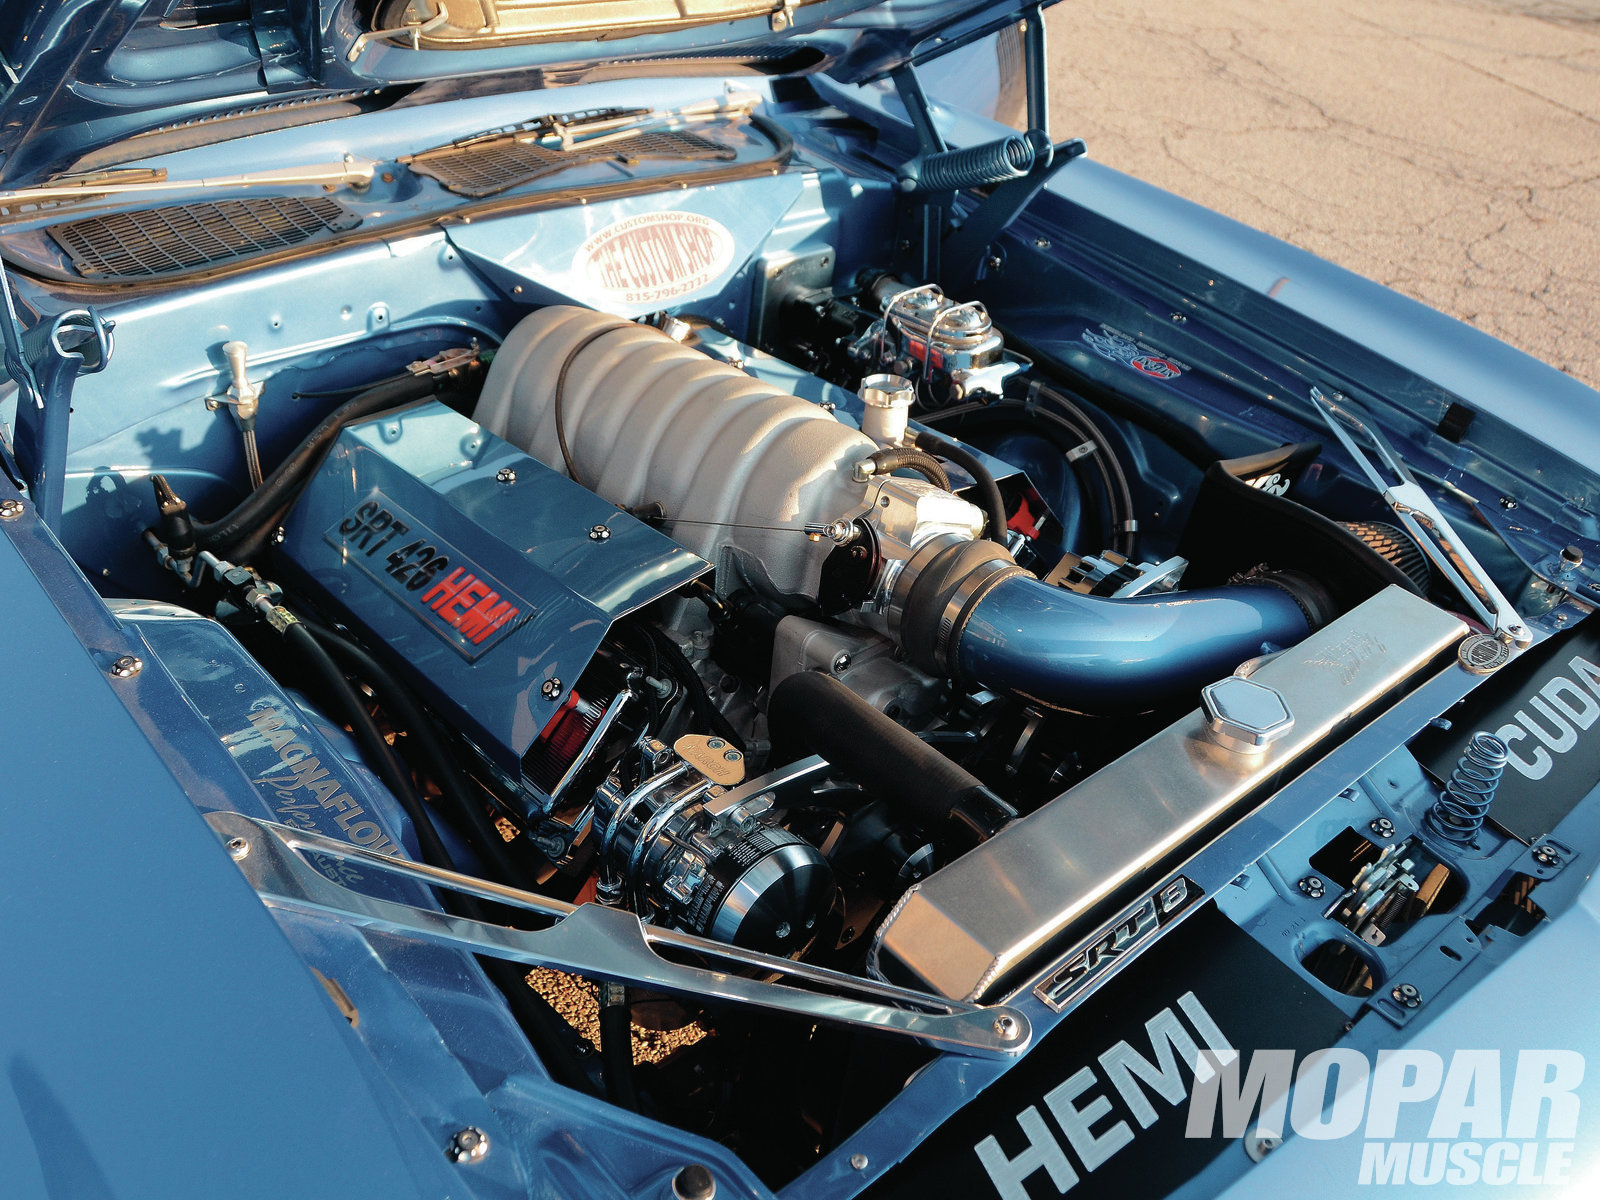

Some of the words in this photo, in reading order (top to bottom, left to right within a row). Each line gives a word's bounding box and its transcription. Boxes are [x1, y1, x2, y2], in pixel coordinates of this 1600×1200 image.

[592, 239, 629, 288] THE
[618, 223, 688, 288] CUSTOM
[674, 222, 716, 274] SHOP
[339, 501, 411, 557] SRT
[385, 538, 450, 591] 426
[421, 566, 520, 645] HEMI
[974, 990, 1237, 1200] HEMI
